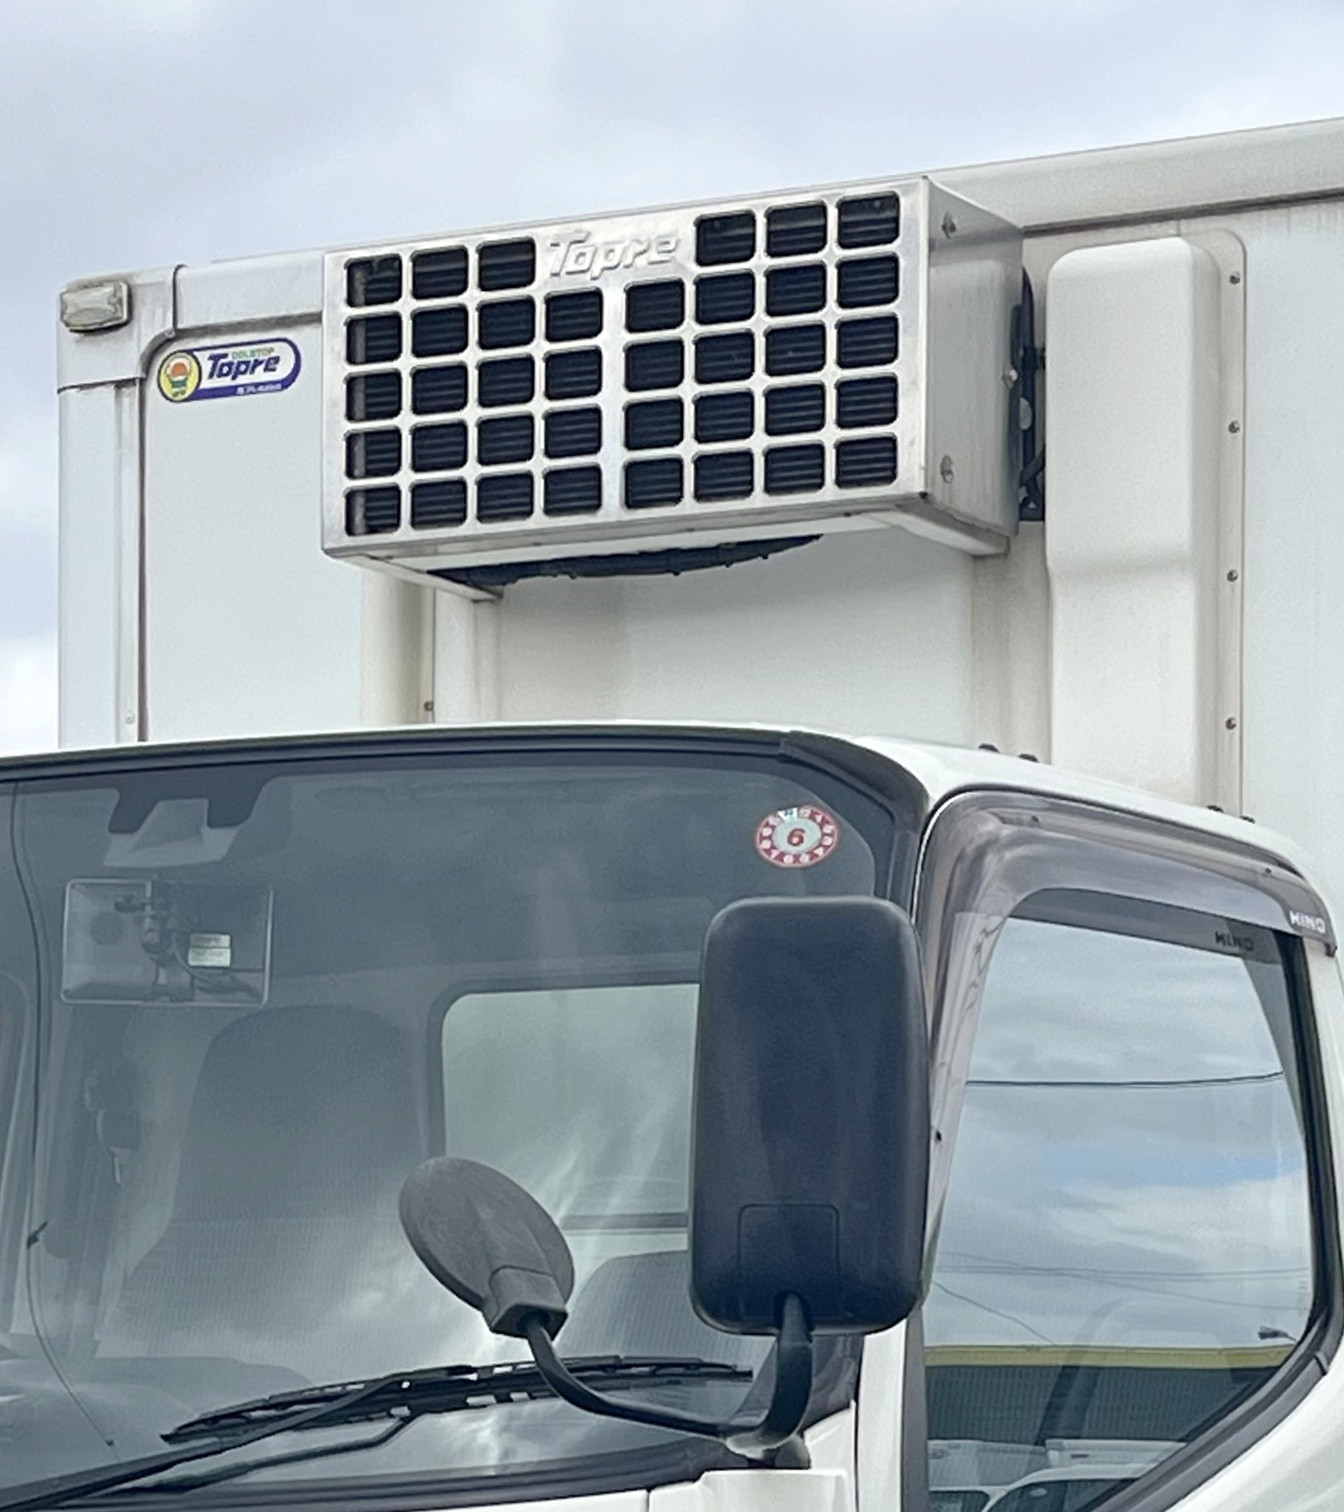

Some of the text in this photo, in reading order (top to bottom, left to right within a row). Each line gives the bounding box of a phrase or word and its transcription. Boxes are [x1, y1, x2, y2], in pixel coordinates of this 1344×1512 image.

[549, 229, 681, 281] Topre
[207, 353, 280, 380] Topre
[1289, 910, 1326, 933] HINO
